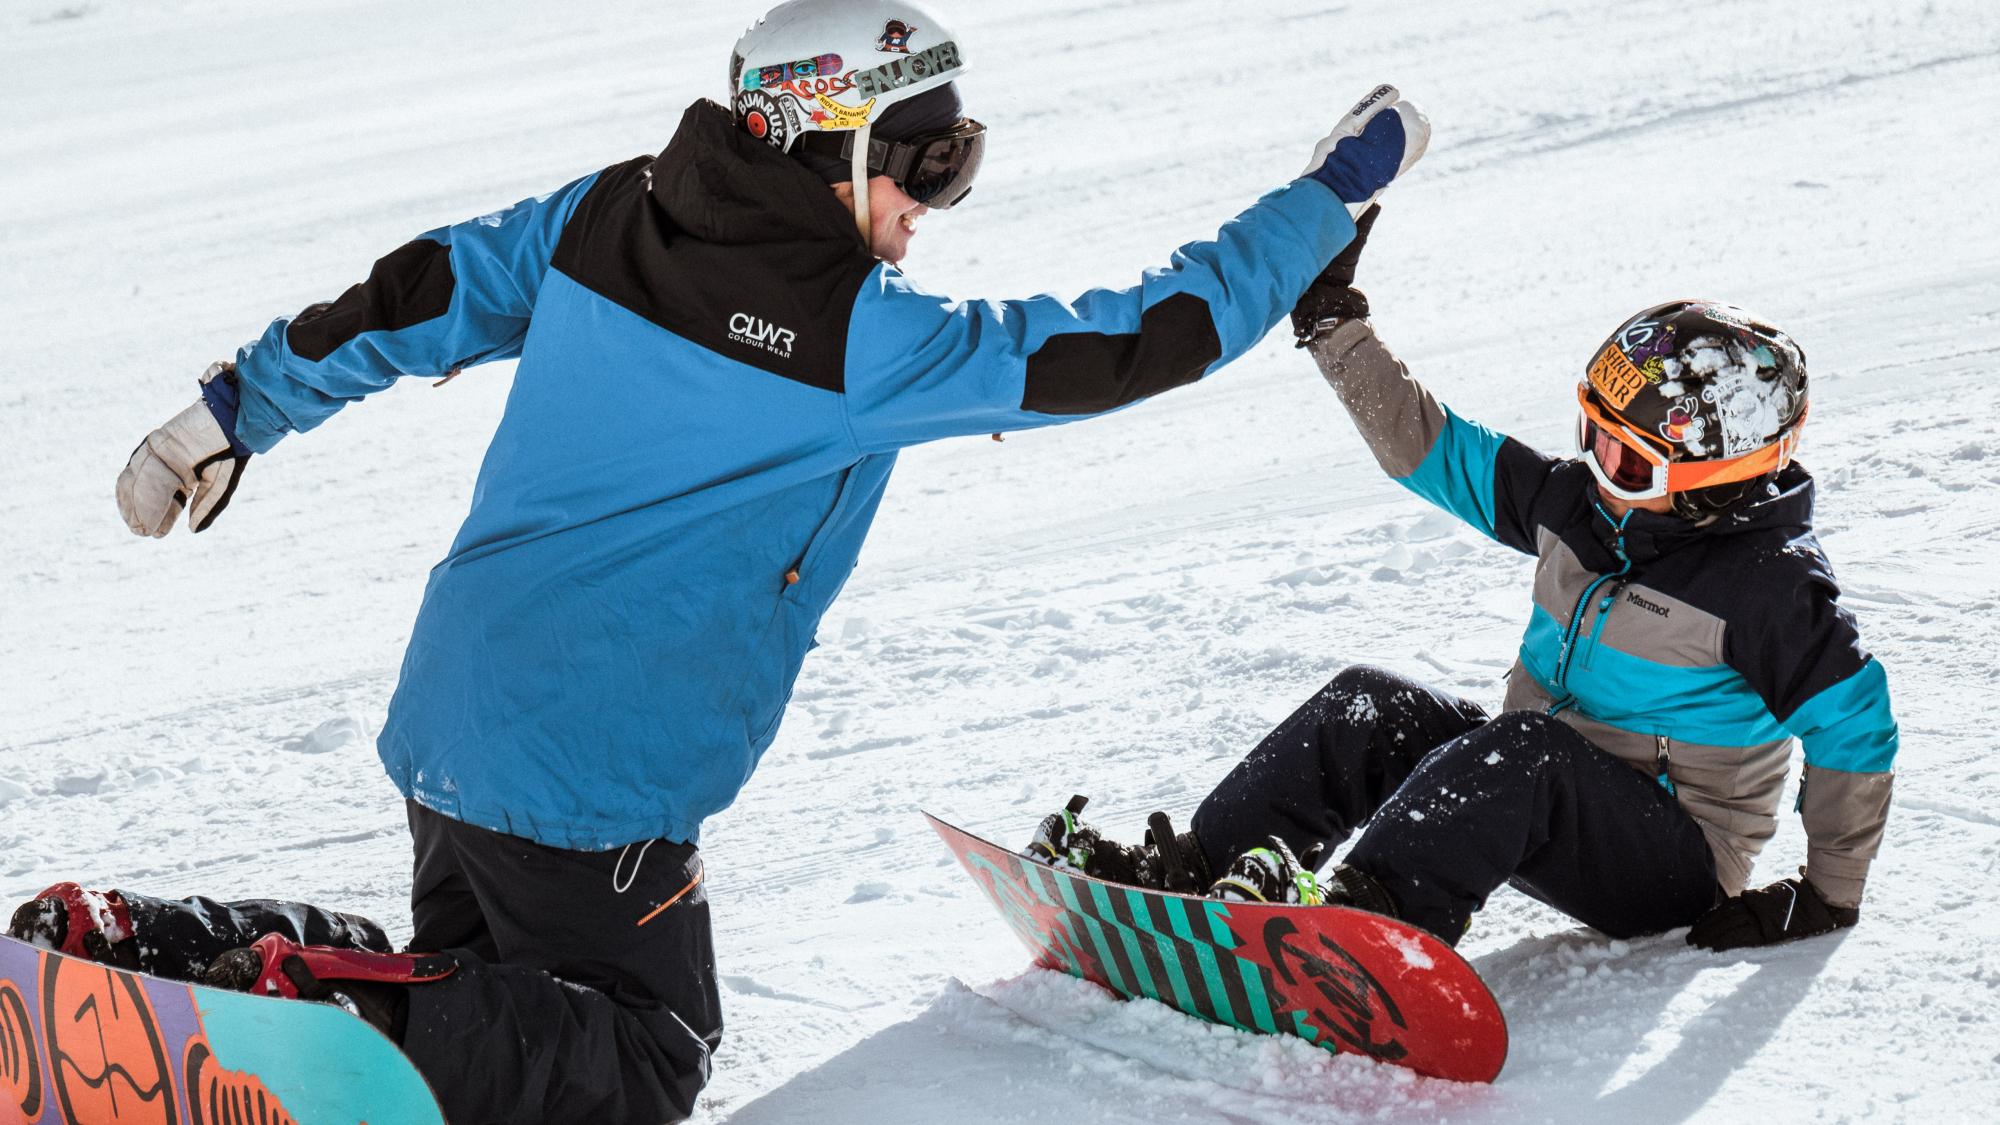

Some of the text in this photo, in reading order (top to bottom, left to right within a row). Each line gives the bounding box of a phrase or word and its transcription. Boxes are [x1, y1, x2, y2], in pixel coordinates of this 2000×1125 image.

[855, 41, 963, 100] ENJOYER
[737, 92, 783, 149] BUMRUSH
[819, 96, 834, 109] RIDE
[1352, 85, 1394, 116] salomon
[727, 332, 791, 359] COLOUR WEAR
[729, 312, 796, 353] CLWR
[1592, 359, 1630, 405] GNAR
[1603, 346, 1643, 390] SHRED
[1625, 591, 1671, 618] Marmot
